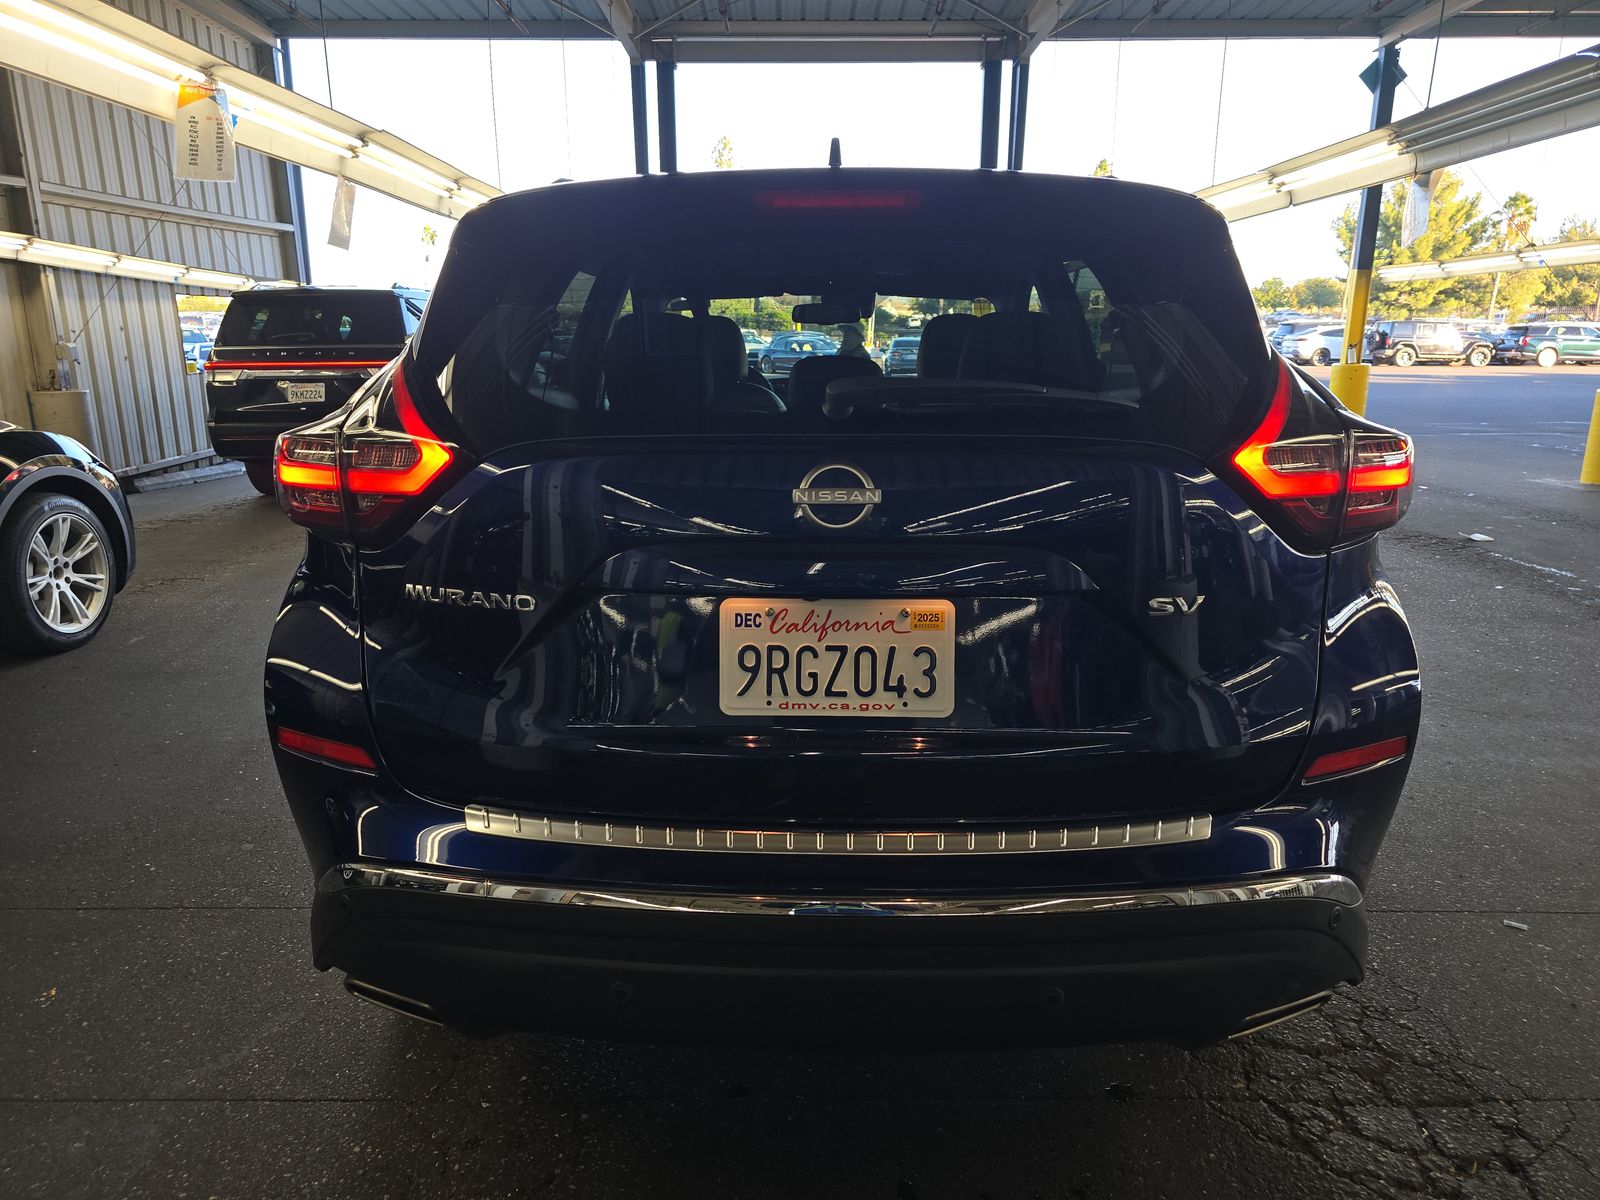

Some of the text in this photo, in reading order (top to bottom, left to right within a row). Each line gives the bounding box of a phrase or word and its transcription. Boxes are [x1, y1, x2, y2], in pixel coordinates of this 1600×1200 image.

[795, 491, 879, 502] NISSAN
[404, 583, 536, 611] MURANO
[1148, 594, 1205, 616] SV
[735, 613, 762, 628] DEC
[769, 608, 911, 642] California
[917, 613, 940, 623] 2025
[736, 644, 938, 698] 9RGZ043
[778, 701, 896, 712] dmv.ca.gov
